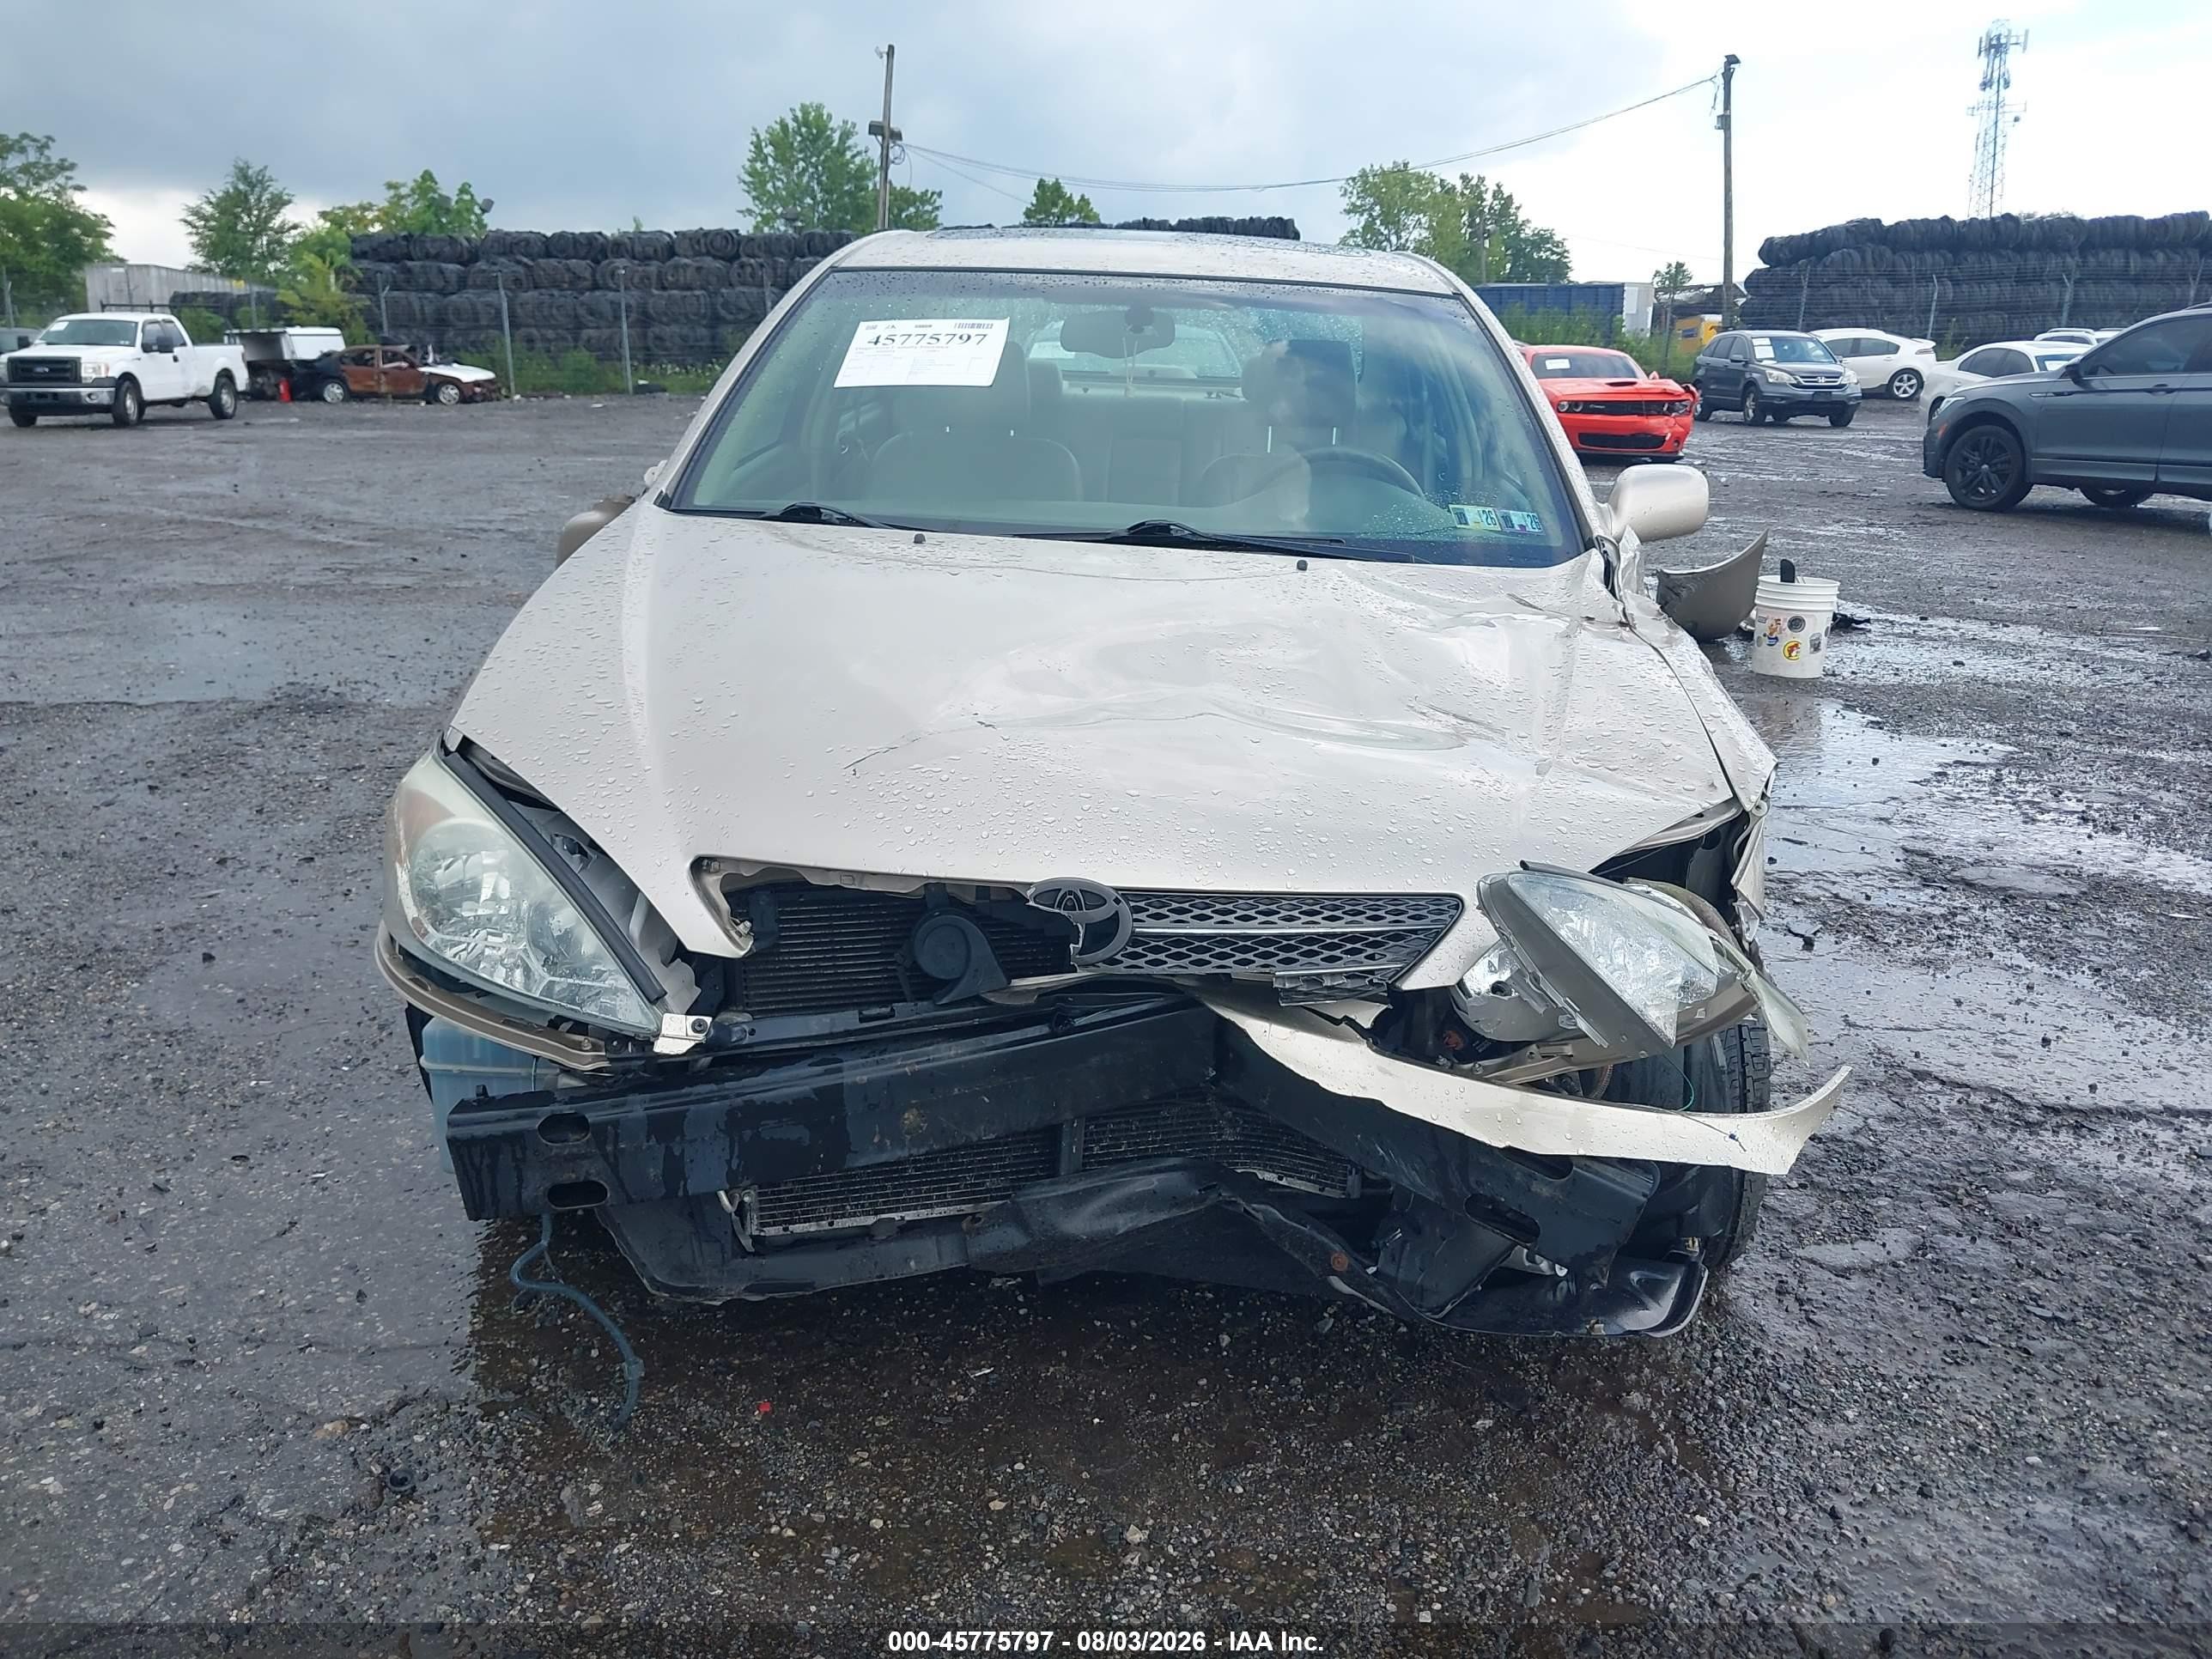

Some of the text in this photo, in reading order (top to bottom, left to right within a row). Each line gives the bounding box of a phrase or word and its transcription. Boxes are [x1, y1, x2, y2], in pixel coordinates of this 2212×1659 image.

[866, 333, 988, 345] 45775797
[1482, 509, 1497, 526] 26
[1528, 514, 1541, 530] 26
